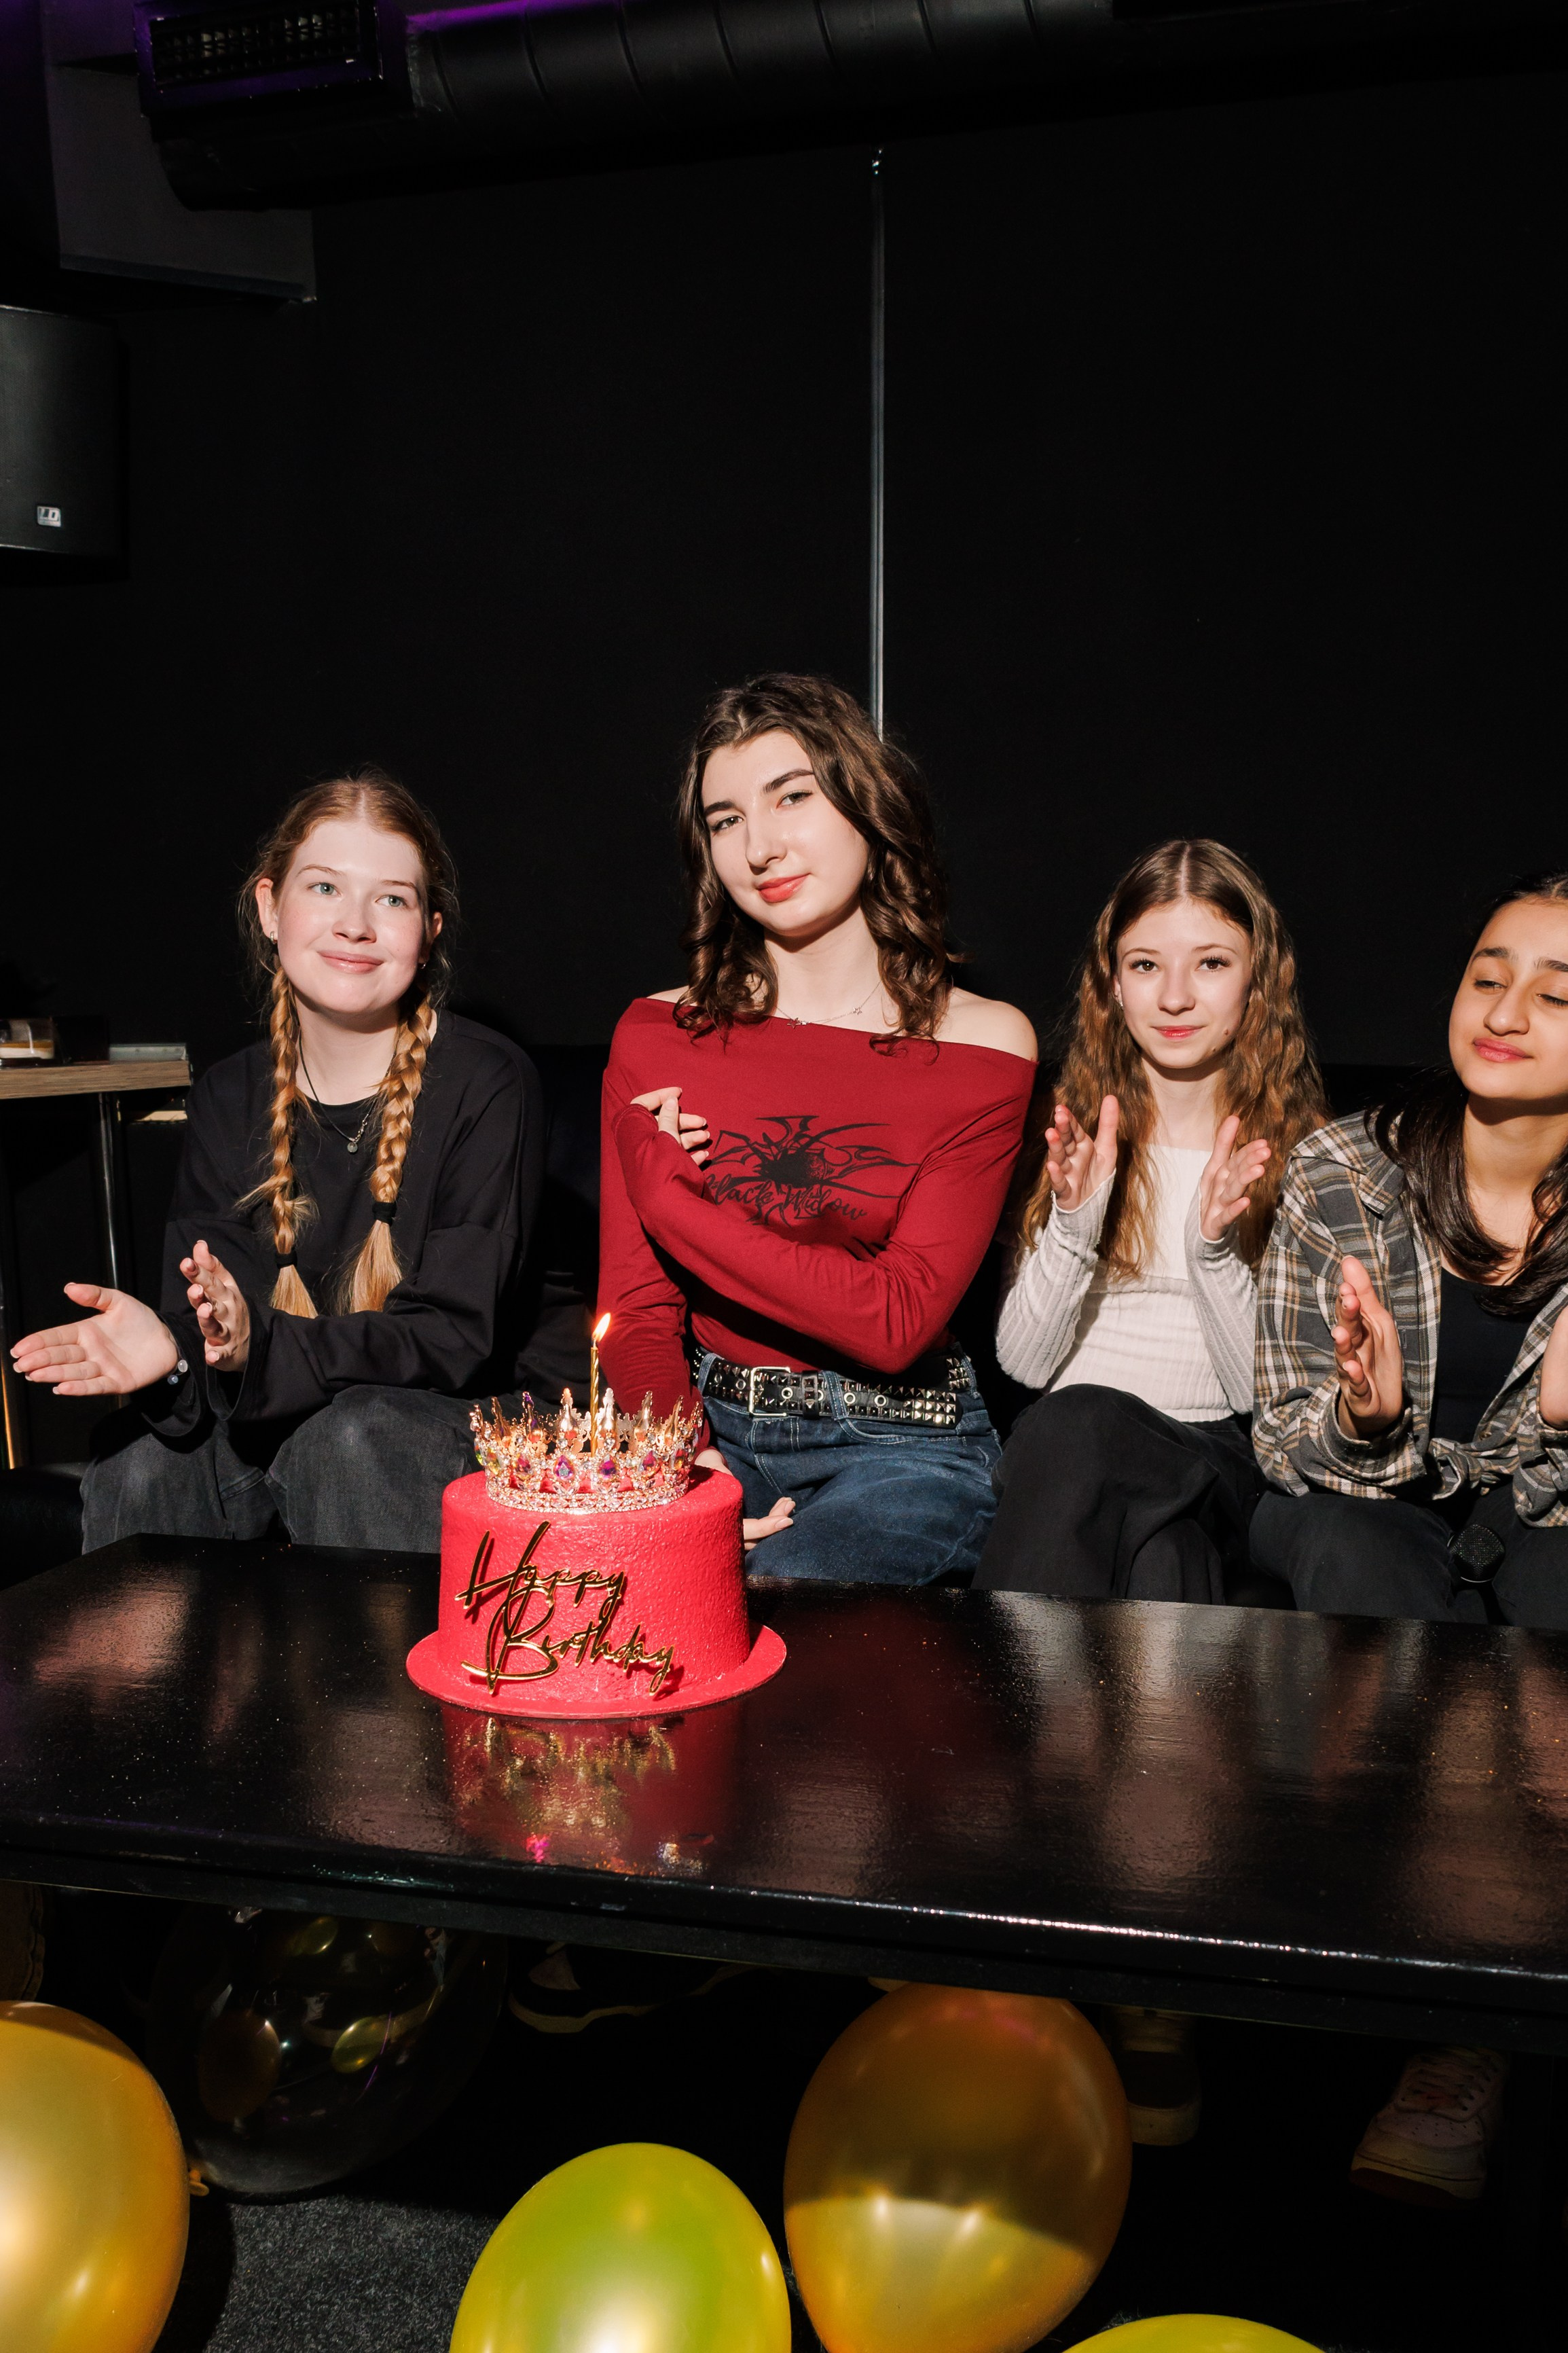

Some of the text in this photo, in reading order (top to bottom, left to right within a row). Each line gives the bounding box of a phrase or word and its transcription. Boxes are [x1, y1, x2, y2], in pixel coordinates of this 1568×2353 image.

[782, 1184, 867, 1221] Widow
[454, 1520, 624, 1632] Happy
[461, 1586, 674, 1696] Birthday
